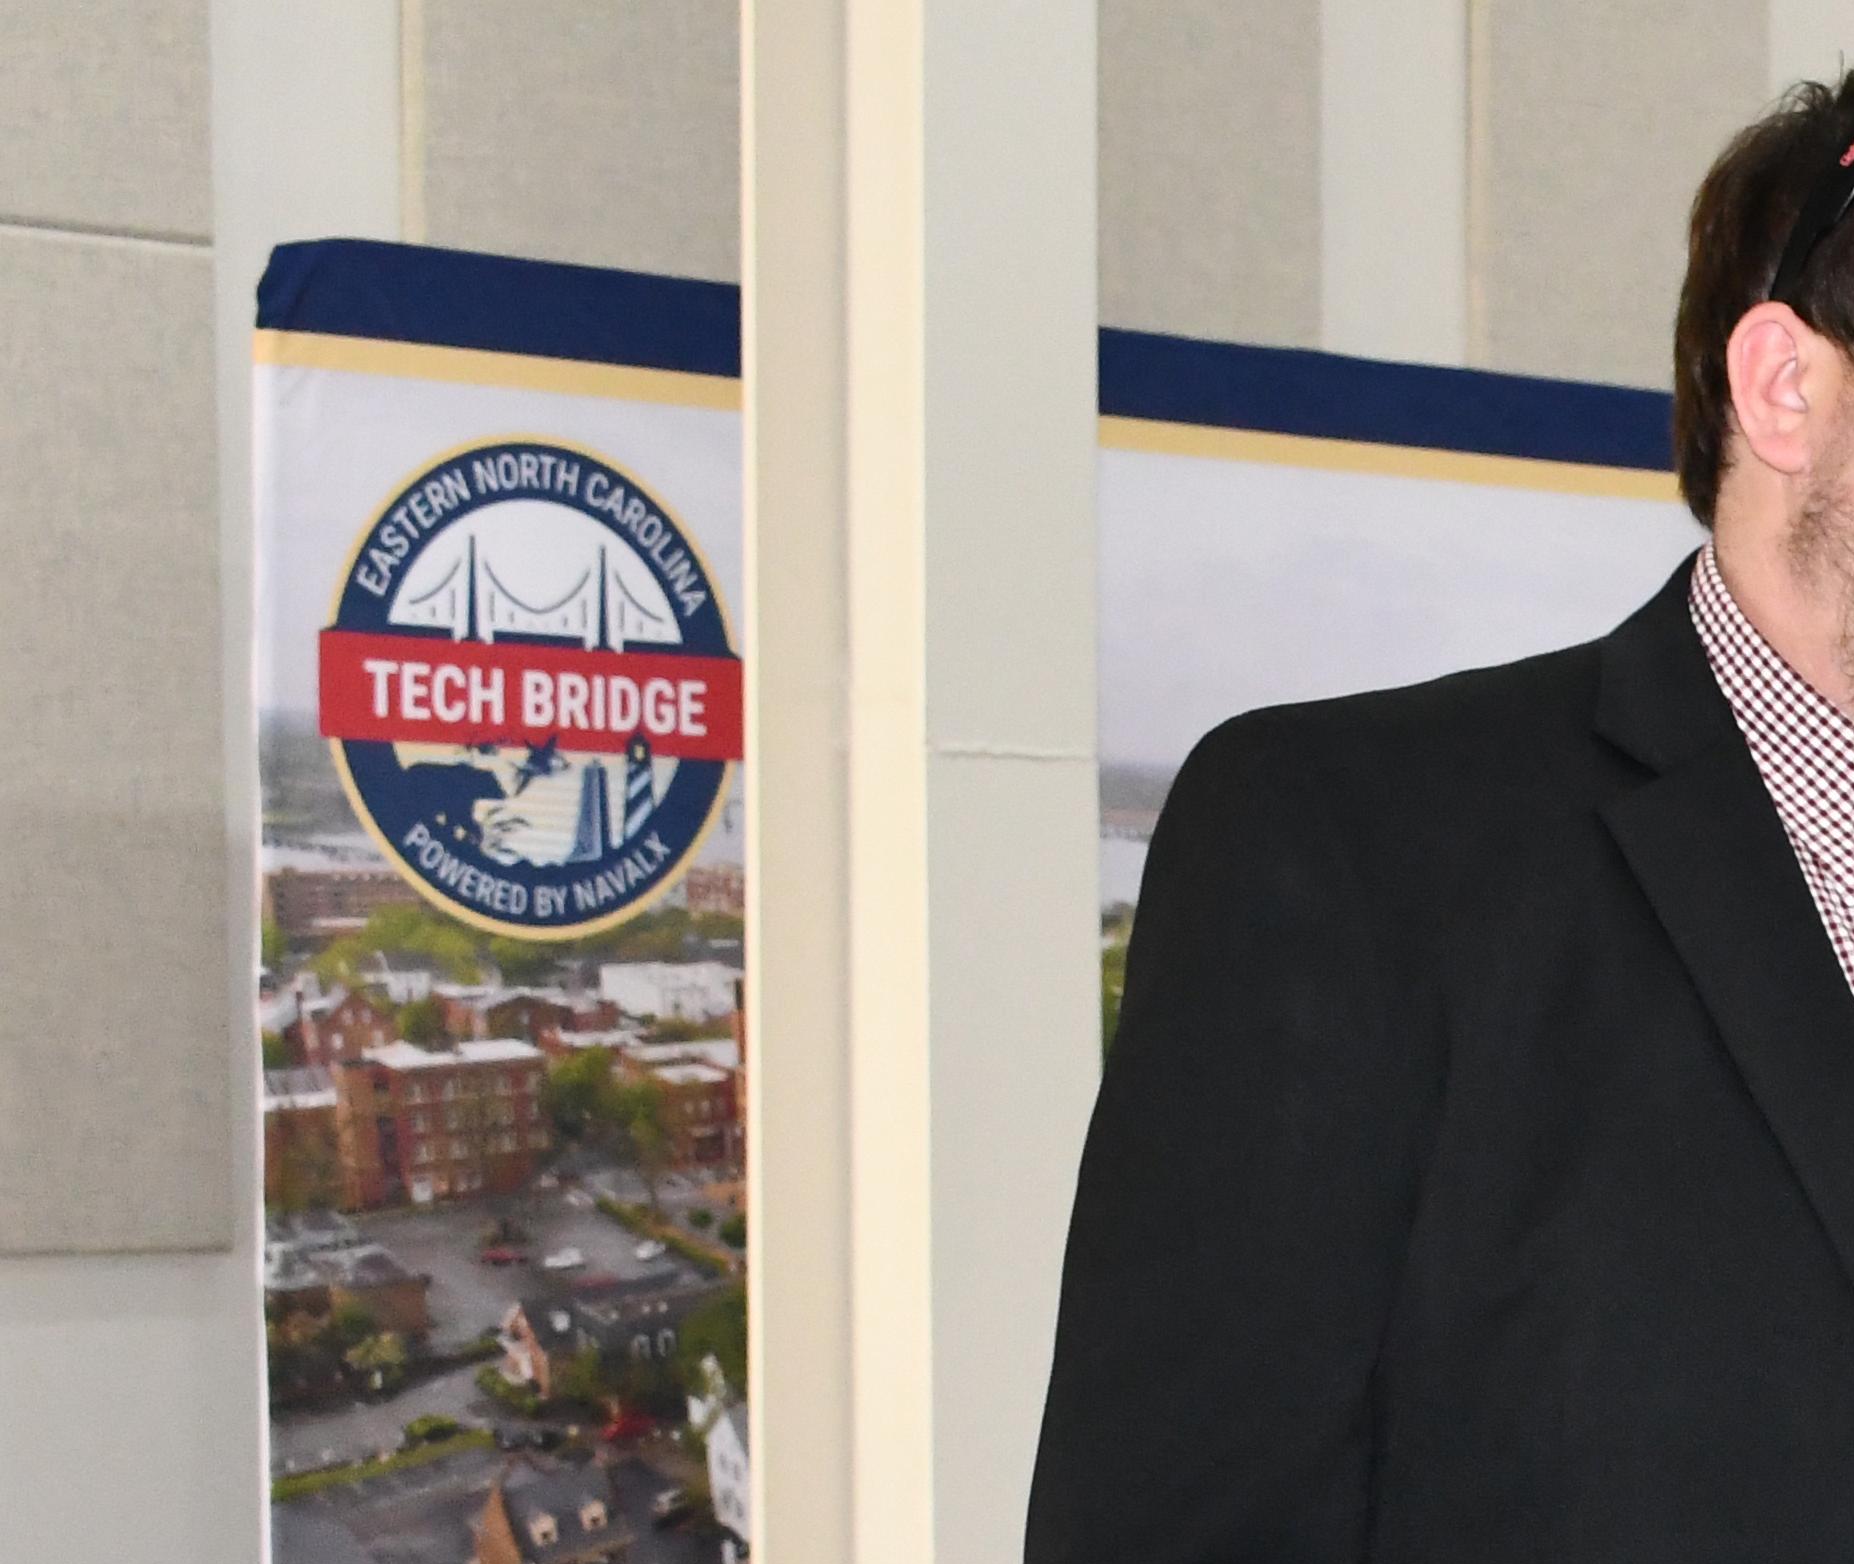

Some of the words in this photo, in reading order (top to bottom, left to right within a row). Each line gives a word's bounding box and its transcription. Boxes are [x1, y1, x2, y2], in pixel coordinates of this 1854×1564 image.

[356, 470, 471, 597] EASTERN
[473, 453, 580, 496] NORTH
[584, 472, 706, 618] CAROLINA
[363, 659, 504, 724] TECH
[522, 670, 707, 737] BRIDGE
[404, 824, 525, 916] POWERED
[534, 886, 568, 917] BY
[576, 831, 671, 910] NAVALX
